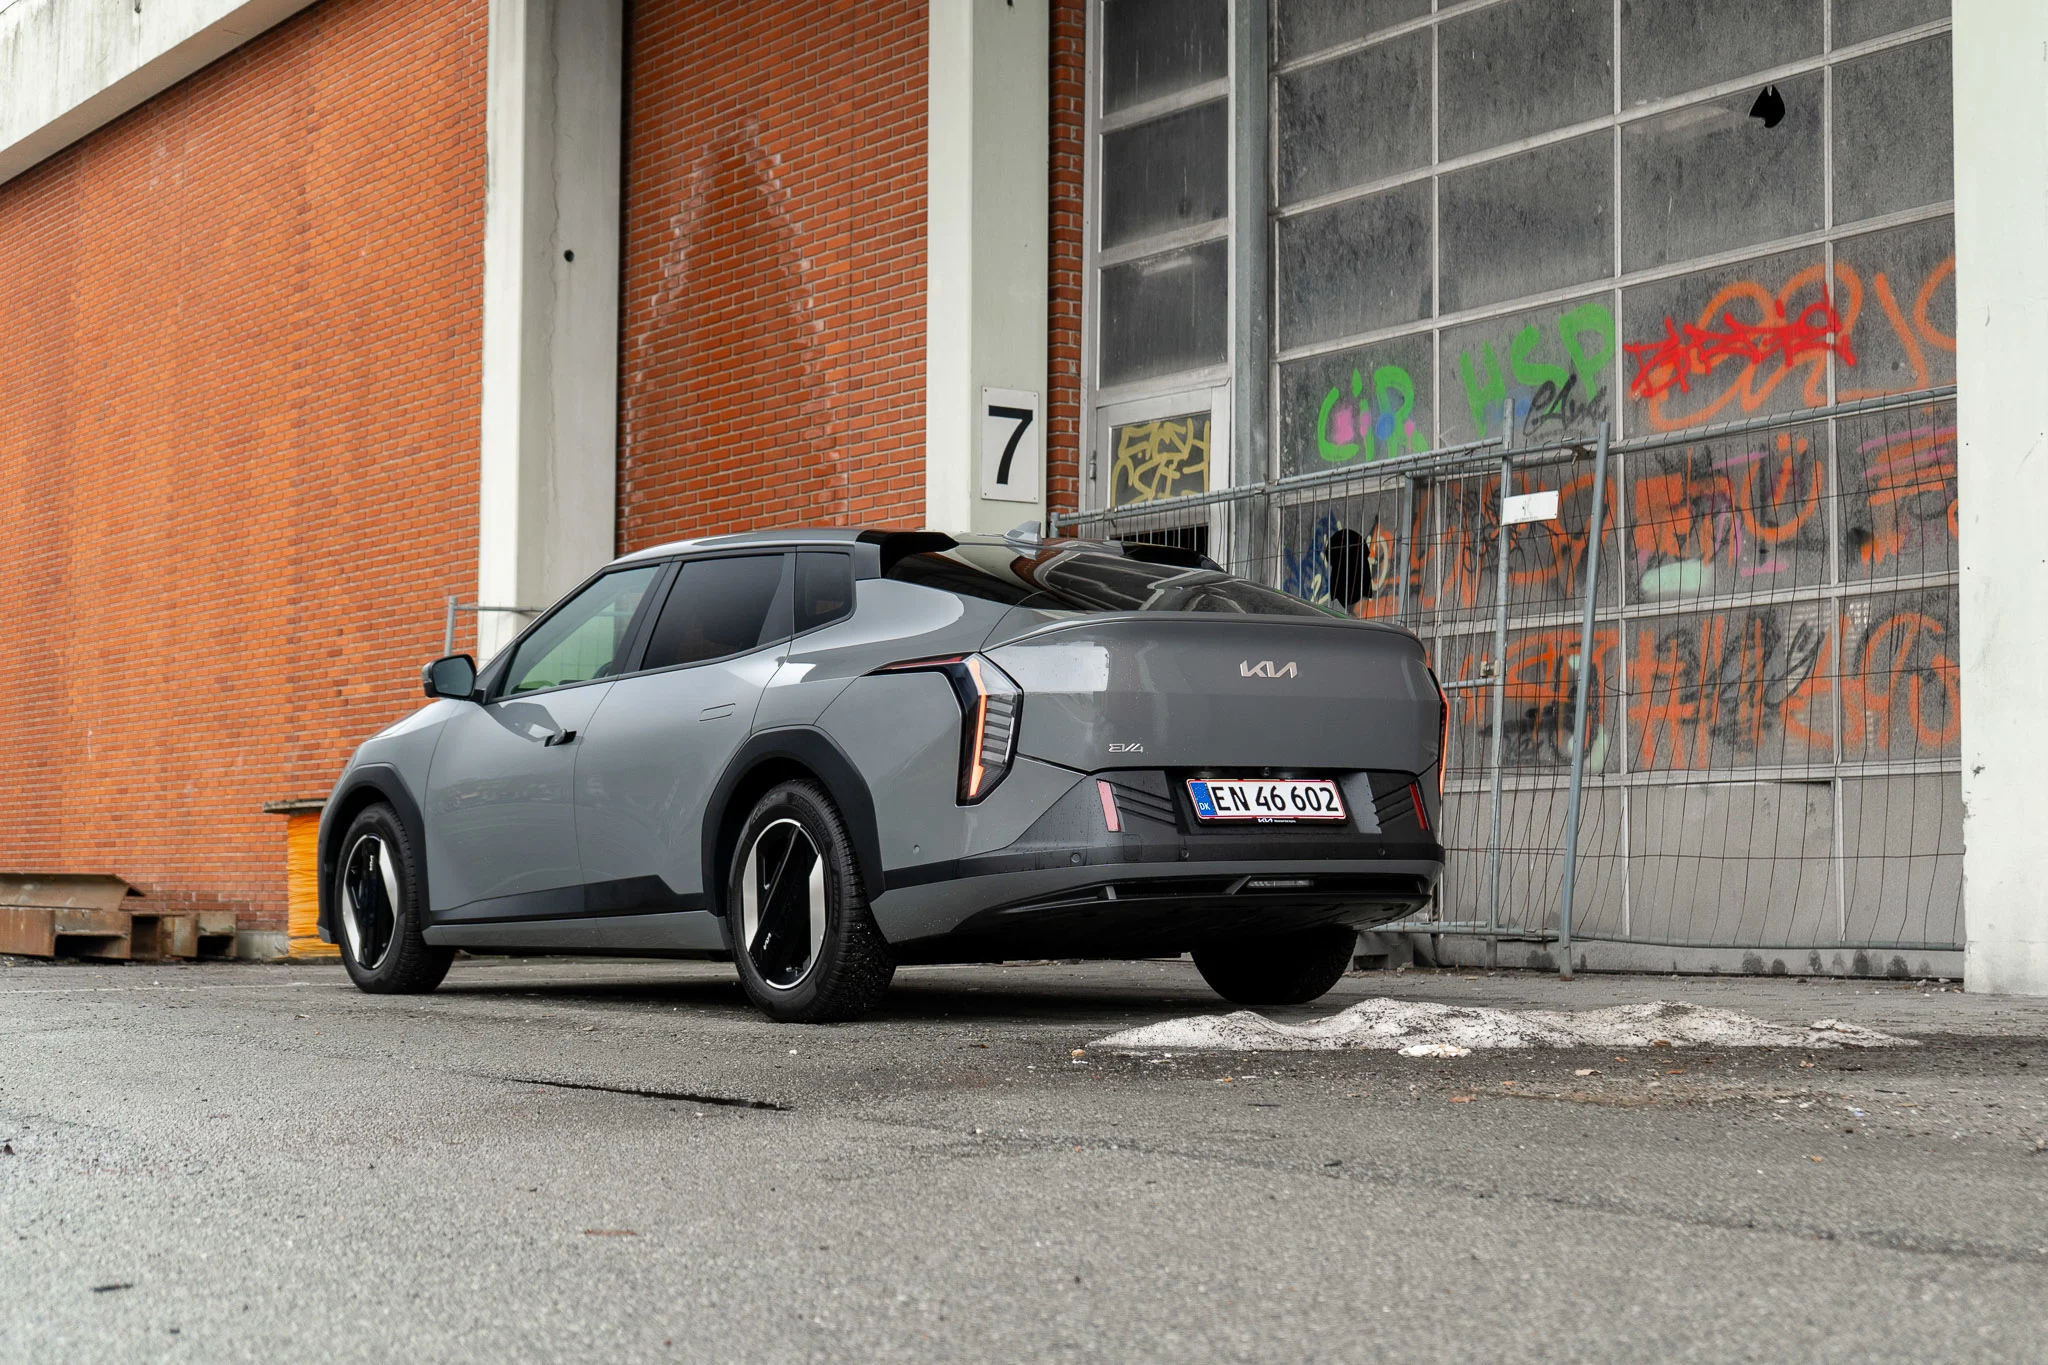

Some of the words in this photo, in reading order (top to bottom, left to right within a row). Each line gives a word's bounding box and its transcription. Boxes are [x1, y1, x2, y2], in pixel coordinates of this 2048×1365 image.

[988, 405, 1033, 485] 7
[1239, 660, 1298, 679] KIA
[1108, 743, 1144, 753] EV4
[1199, 802, 1211, 811] DK
[1211, 786, 1251, 811] EN
[1255, 785, 1286, 811] 46
[1290, 785, 1339, 811] 602
